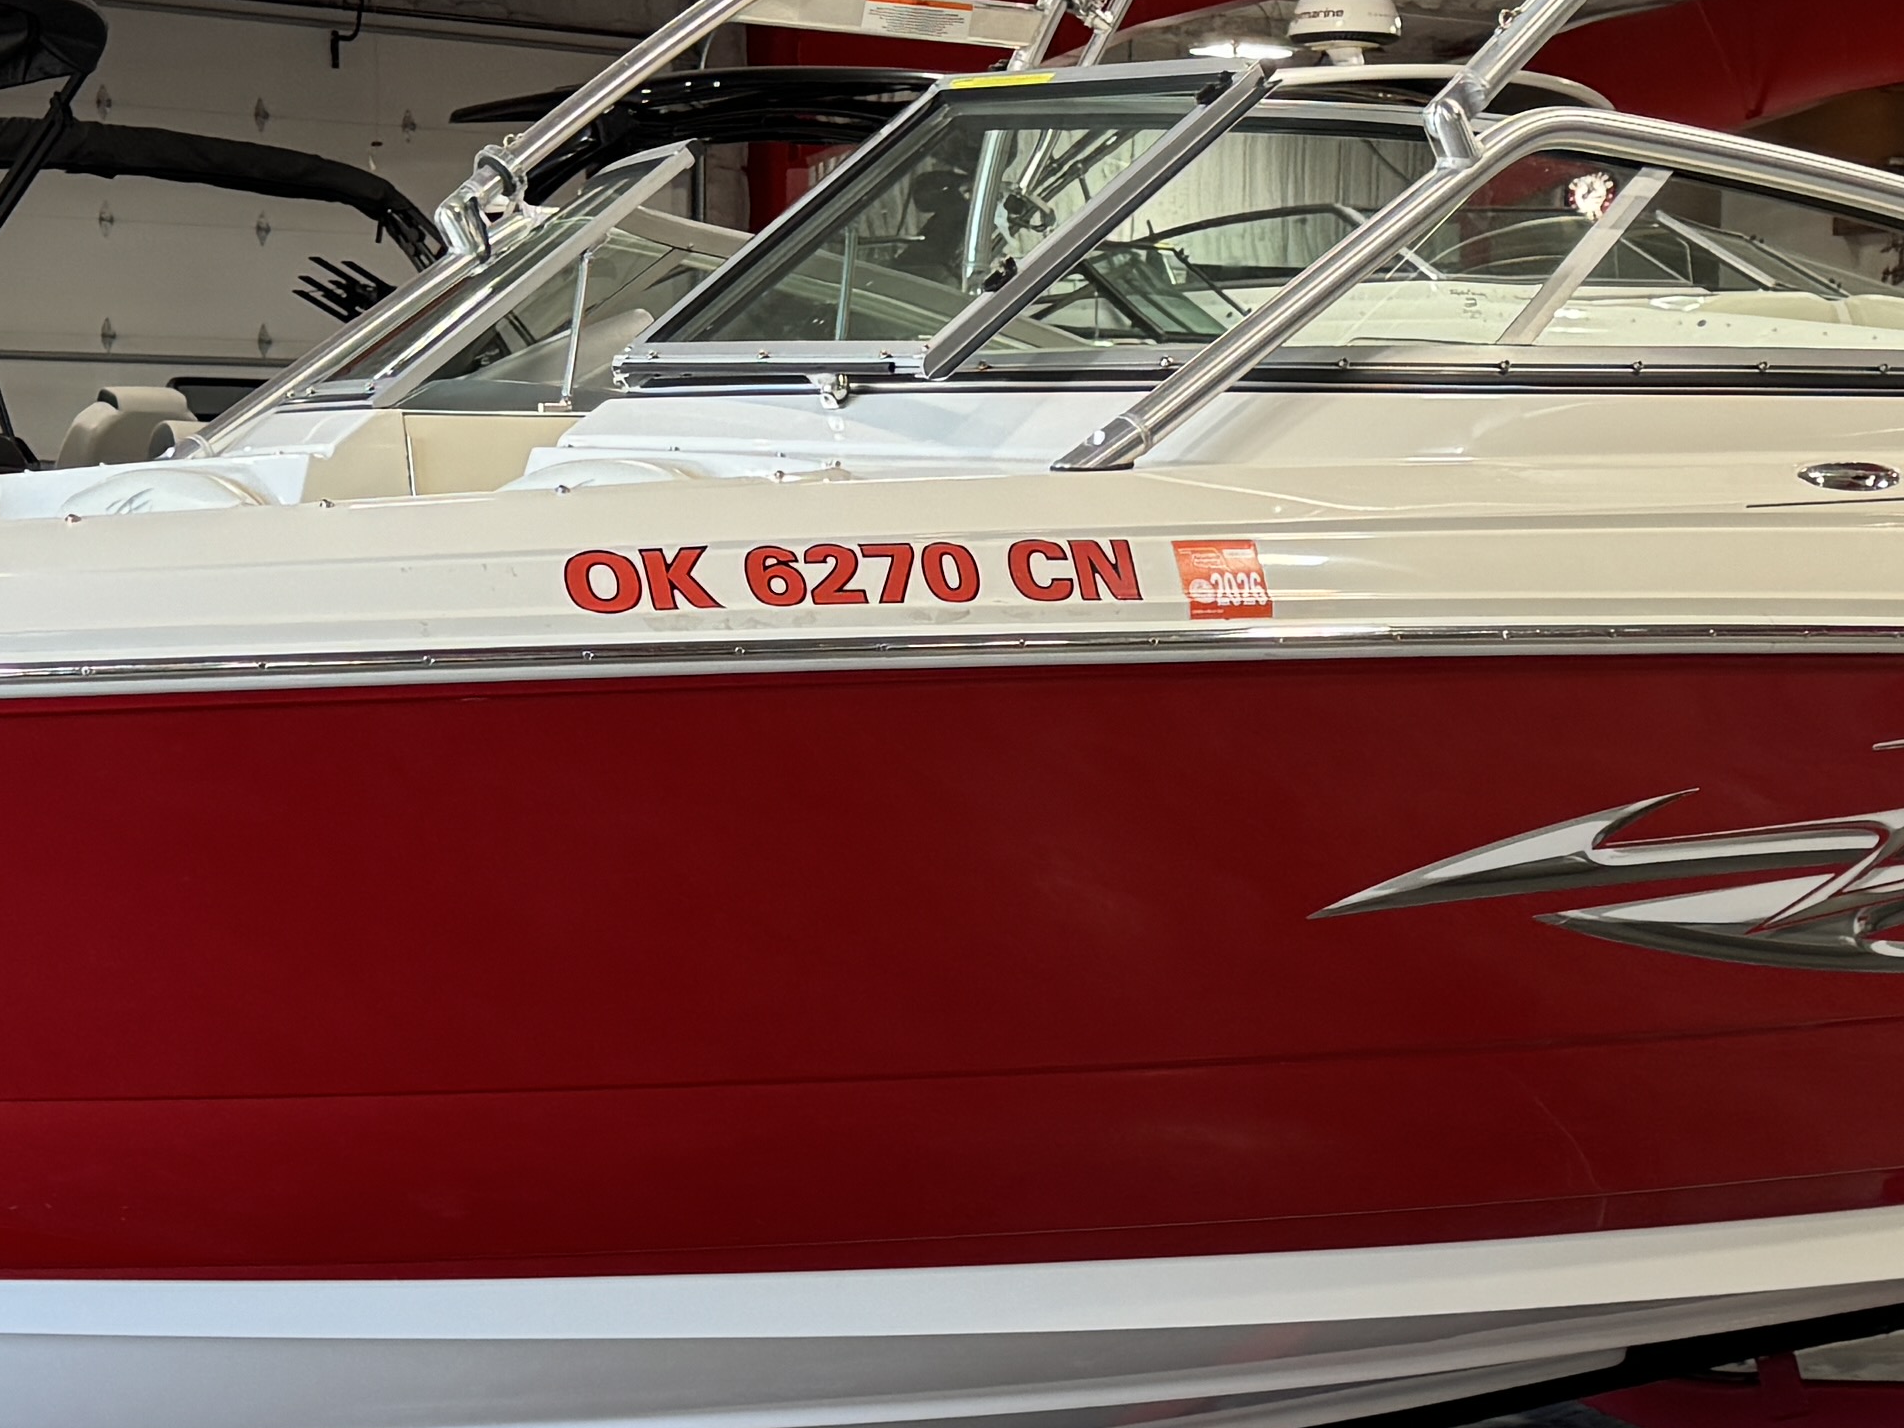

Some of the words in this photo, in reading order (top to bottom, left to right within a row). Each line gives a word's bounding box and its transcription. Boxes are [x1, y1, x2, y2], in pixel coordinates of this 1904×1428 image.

[564, 545, 726, 613] OK
[744, 541, 981, 607] 6270
[1008, 538, 1143, 603] CN
[1210, 572, 1268, 606] 2026
